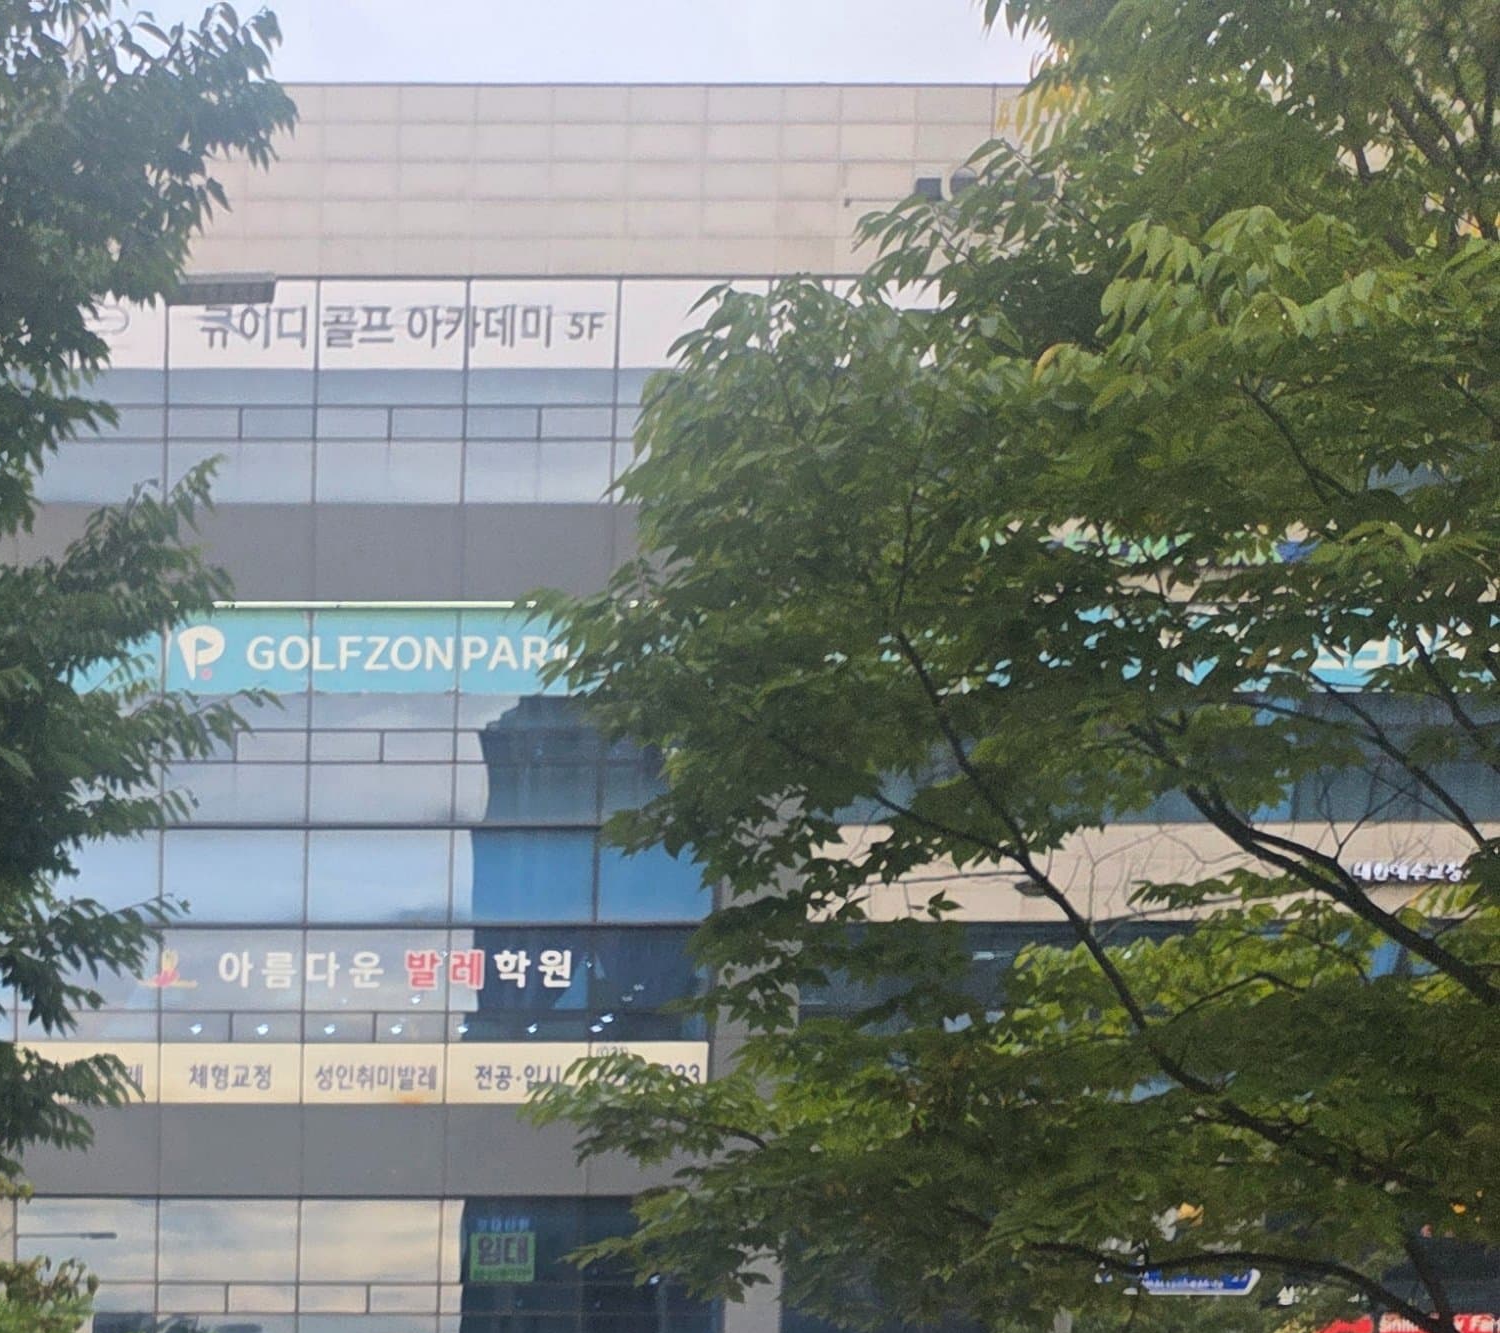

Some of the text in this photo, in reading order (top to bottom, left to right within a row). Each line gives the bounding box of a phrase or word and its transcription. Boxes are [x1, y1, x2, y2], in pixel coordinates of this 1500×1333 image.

[323, 304, 395, 349] 골프
[407, 303, 552, 349] 아카데미
[567, 311, 605, 341] 5F
[246, 635, 570, 671] GOLFZONPAR
[217, 951, 385, 989] 아름다운
[189, 1064, 272, 1090] 체형교정
[315, 1064, 437, 1091] 성인취미발레
